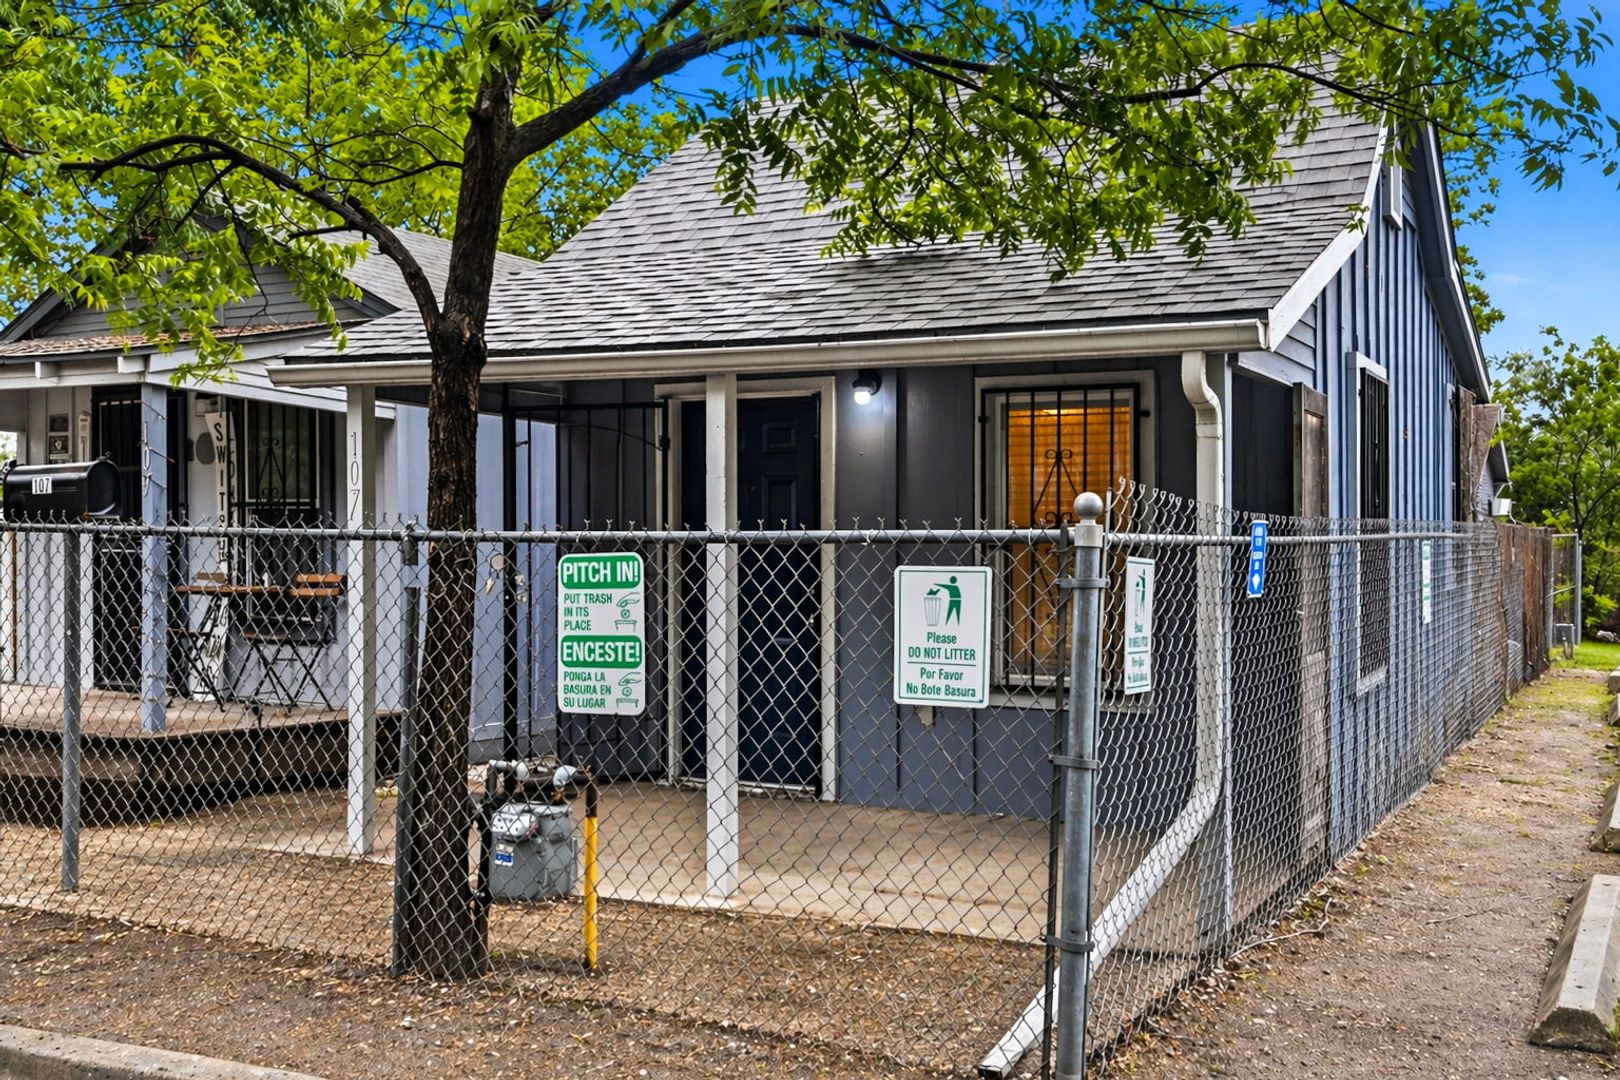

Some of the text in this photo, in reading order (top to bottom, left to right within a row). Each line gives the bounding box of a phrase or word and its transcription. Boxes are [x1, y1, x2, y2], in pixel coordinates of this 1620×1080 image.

[349, 431, 361, 521] 107
[33, 477, 51, 494] 107
[562, 560, 639, 583] PITCH IN!
[564, 593, 613, 605] PUT TRASH
[564, 606, 590, 618] IN ITS
[564, 619, 592, 632] PLACE
[926, 631, 957, 645] Please
[562, 641, 641, 662] ENCESTE!
[908, 646, 976, 661] DO NOT LITTER
[564, 671, 606, 683] PONGA LA
[920, 667, 964, 681] Por Favor
[563, 684, 612, 696] BASURA EN
[906, 682, 976, 698] No Bote Basura
[563, 697, 606, 709] SU LUGAR
